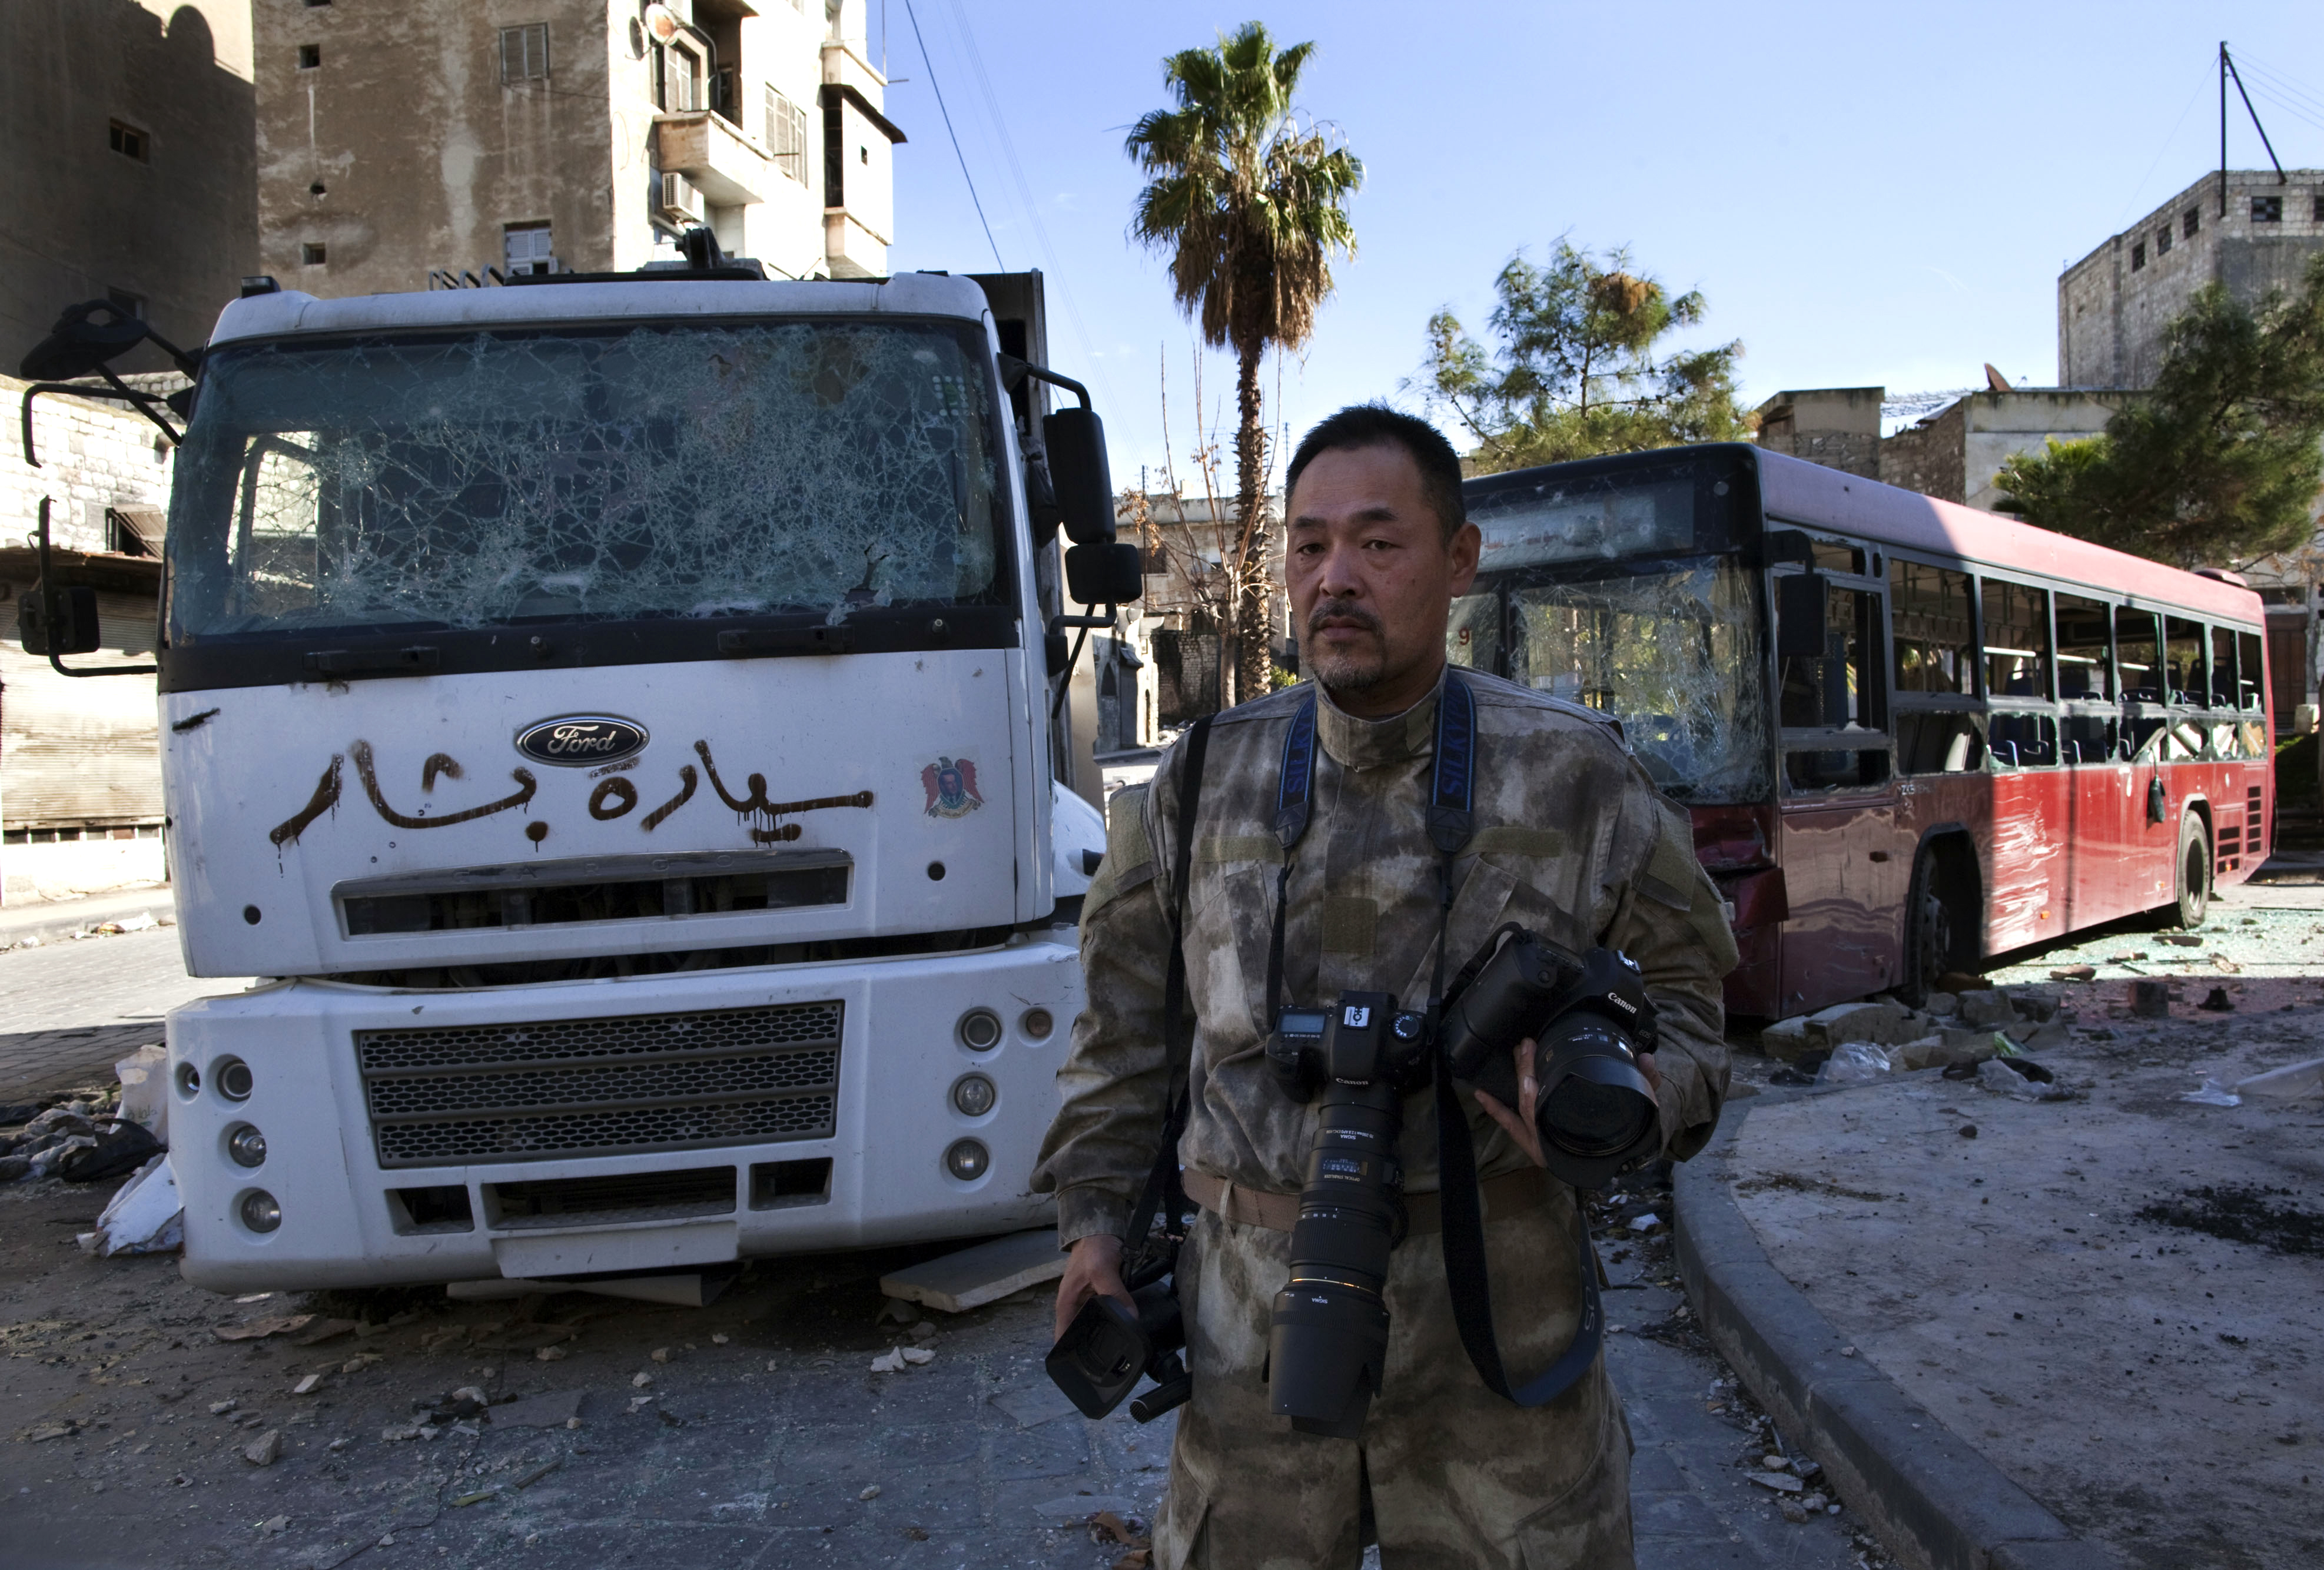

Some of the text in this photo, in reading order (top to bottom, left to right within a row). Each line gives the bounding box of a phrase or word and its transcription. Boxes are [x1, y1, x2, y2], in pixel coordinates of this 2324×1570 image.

[547, 725, 617, 754] Ford
[452, 855, 735, 884] CARGO
[1608, 992, 1637, 1014] Canon
